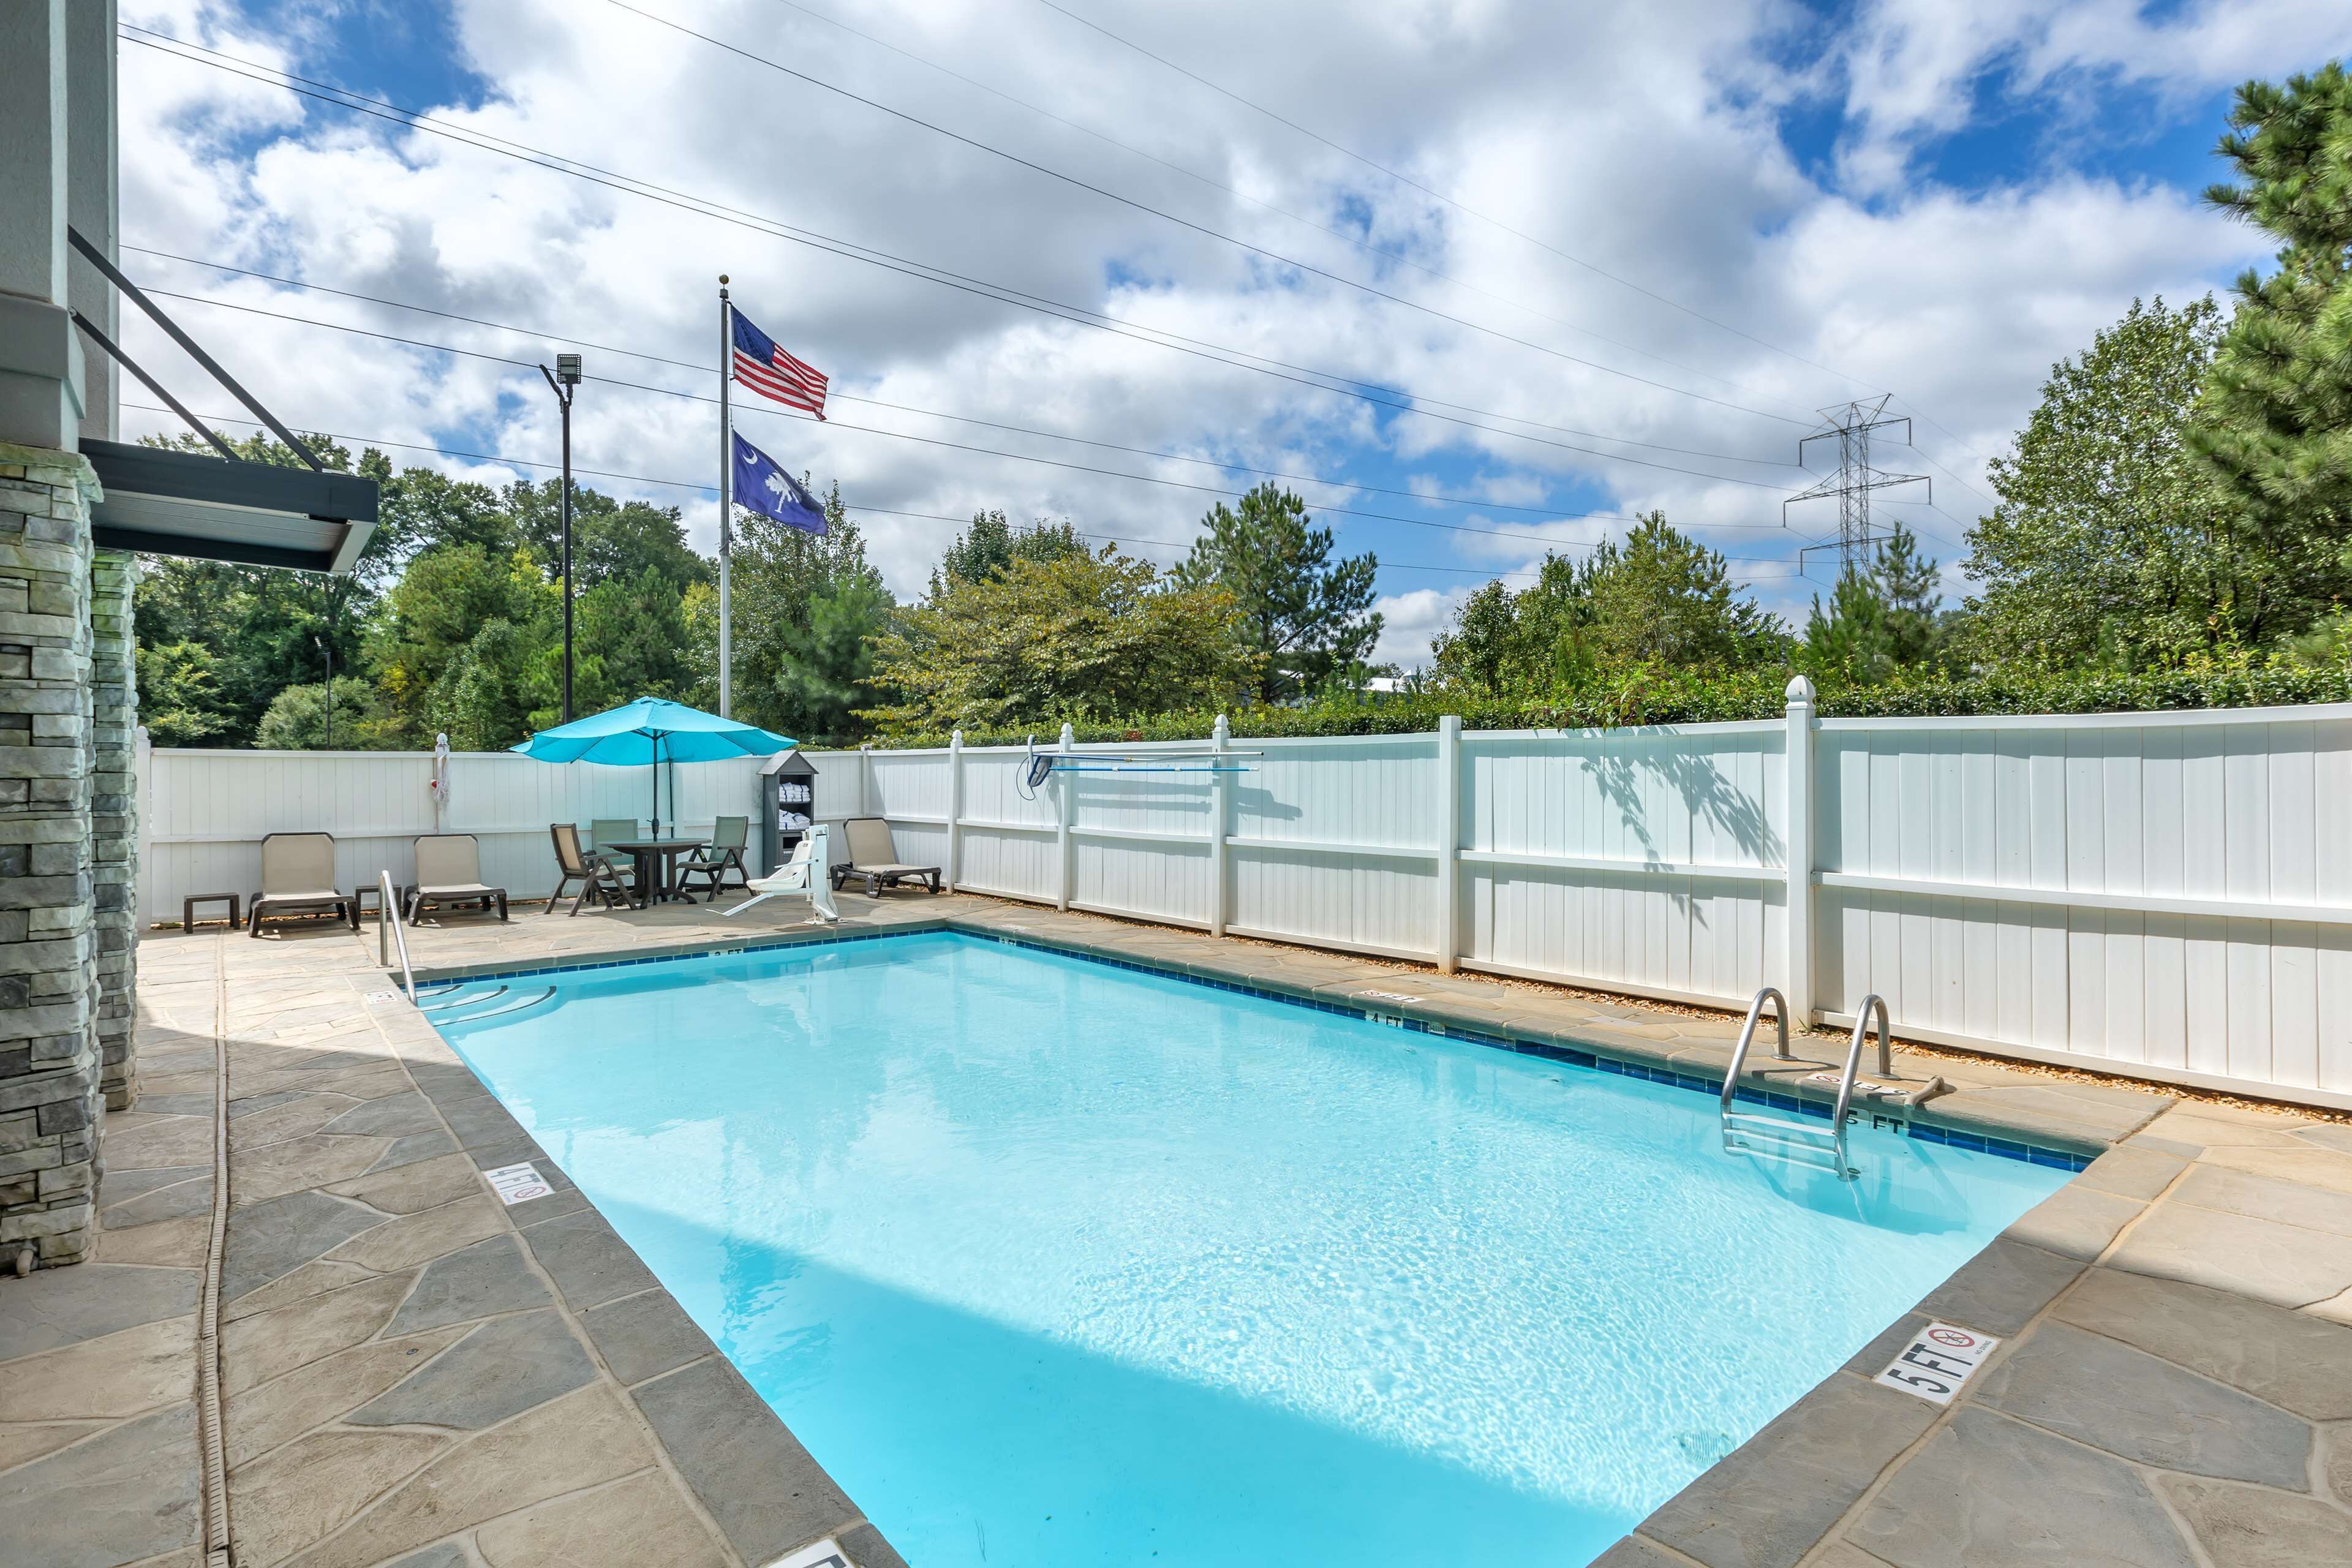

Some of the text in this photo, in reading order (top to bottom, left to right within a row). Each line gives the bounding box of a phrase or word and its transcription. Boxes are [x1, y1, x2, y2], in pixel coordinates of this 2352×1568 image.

[1371, 1013, 1401, 1027] 4 FT
[1846, 1109, 1904, 1134] 5 FT
[490, 1167, 541, 1190] 4 FT
[1887, 1343, 1973, 1393] 5 FT
